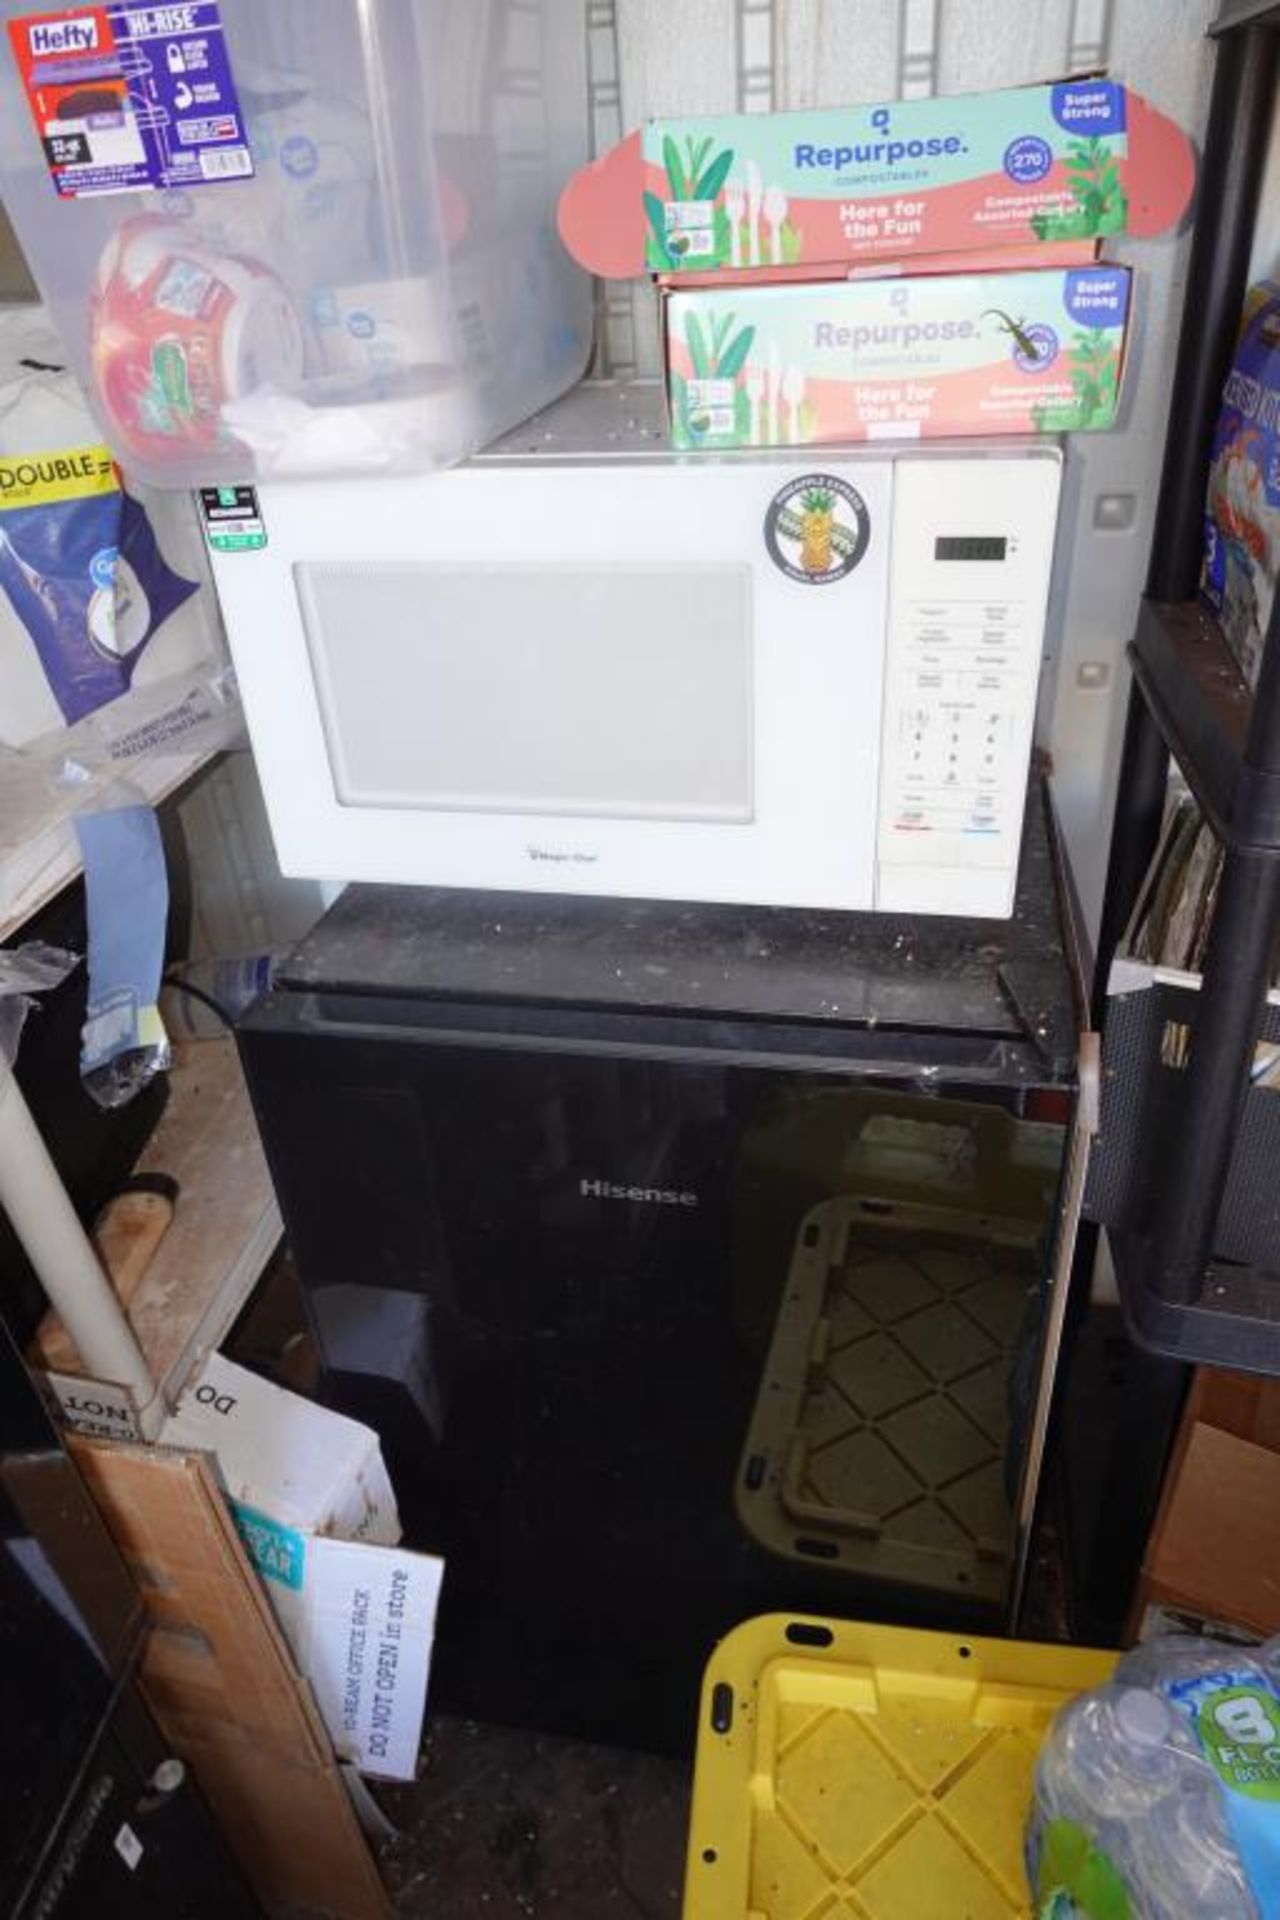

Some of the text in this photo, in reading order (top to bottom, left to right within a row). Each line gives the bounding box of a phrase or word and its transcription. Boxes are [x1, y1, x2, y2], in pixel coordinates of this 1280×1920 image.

[129, 8, 195, 36] HI-RISE
[33, 24, 94, 52] Hefty
[1061, 104, 1112, 121] Strong
[1063, 92, 1107, 107] Super
[794, 135, 969, 171] Repurpose.
[1013, 152, 1043, 169] 270
[839, 200, 926, 222] Here for
[844, 218, 921, 239] the Fun
[1076, 281, 1117, 295] Super
[1072, 296, 1118, 310] Strong
[814, 319, 981, 351] Repurpose.
[0, 454, 96, 489] DOUBLE
[580, 1178, 699, 1206] Hisense
[64, 1396, 130, 1421] NOT
[195, 1384, 237, 1416] DO
[352, 1588, 370, 1627] PACK
[348, 1628, 366, 1676] OFFICE
[368, 1568, 409, 1758] DO NOT OPEN in store
